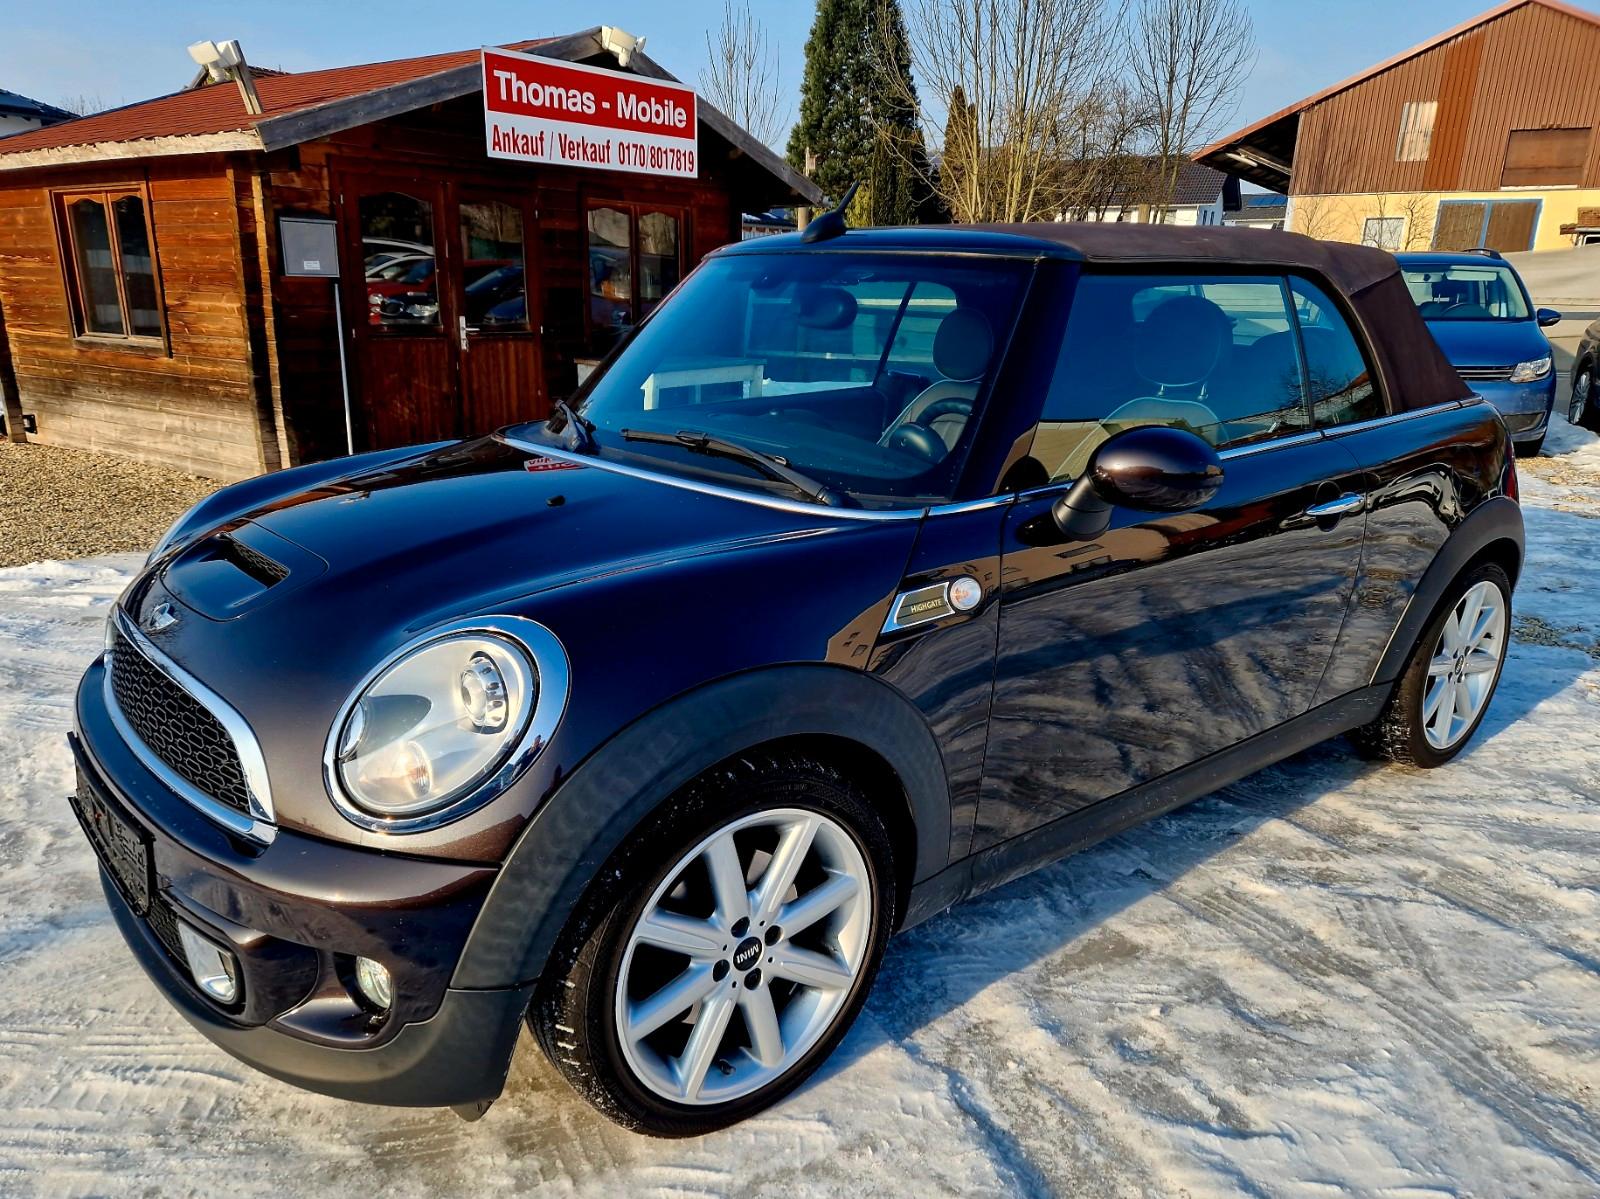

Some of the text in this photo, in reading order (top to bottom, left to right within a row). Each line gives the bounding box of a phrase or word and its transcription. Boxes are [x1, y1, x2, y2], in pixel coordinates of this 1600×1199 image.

[493, 69, 596, 114] Thomas
[616, 91, 687, 128] Mobile
[492, 124, 545, 157] Ankauf
[558, 132, 611, 163] Verkauf
[618, 141, 694, 172] 0170/8017819
[910, 598, 942, 613] HIGHGATE
[736, 943, 760, 964] MINI
